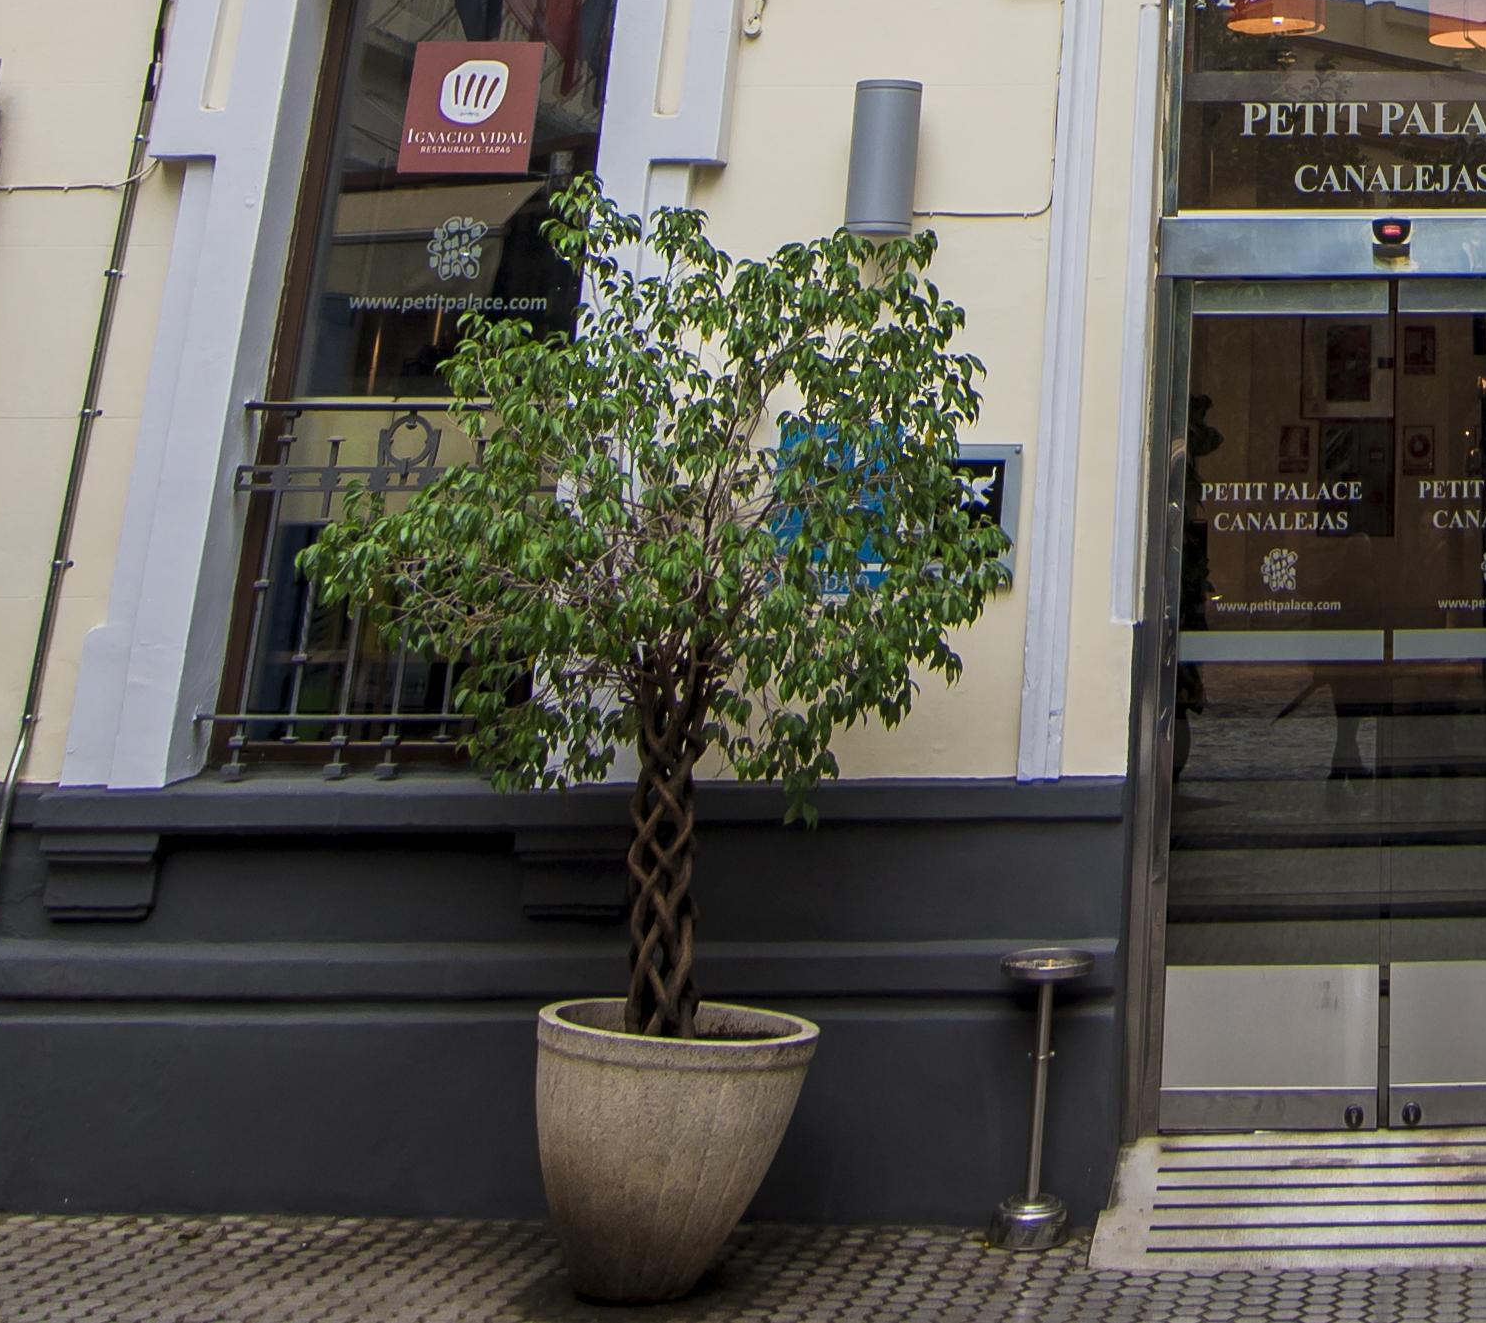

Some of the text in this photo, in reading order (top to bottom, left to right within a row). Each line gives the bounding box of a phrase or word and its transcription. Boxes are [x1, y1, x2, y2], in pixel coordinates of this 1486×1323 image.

[1240, 101, 1368, 136] PETIT
[406, 127, 527, 144] IGNACIO VIDAL
[349, 292, 547, 313] www.petitpalace.com
[1200, 481, 1363, 502] PETIT PALACE
[1418, 480, 1485, 499] PETIT
[1214, 511, 1349, 531] CANALEJAS
[1216, 599, 1341, 614] www.petitpalace.com
